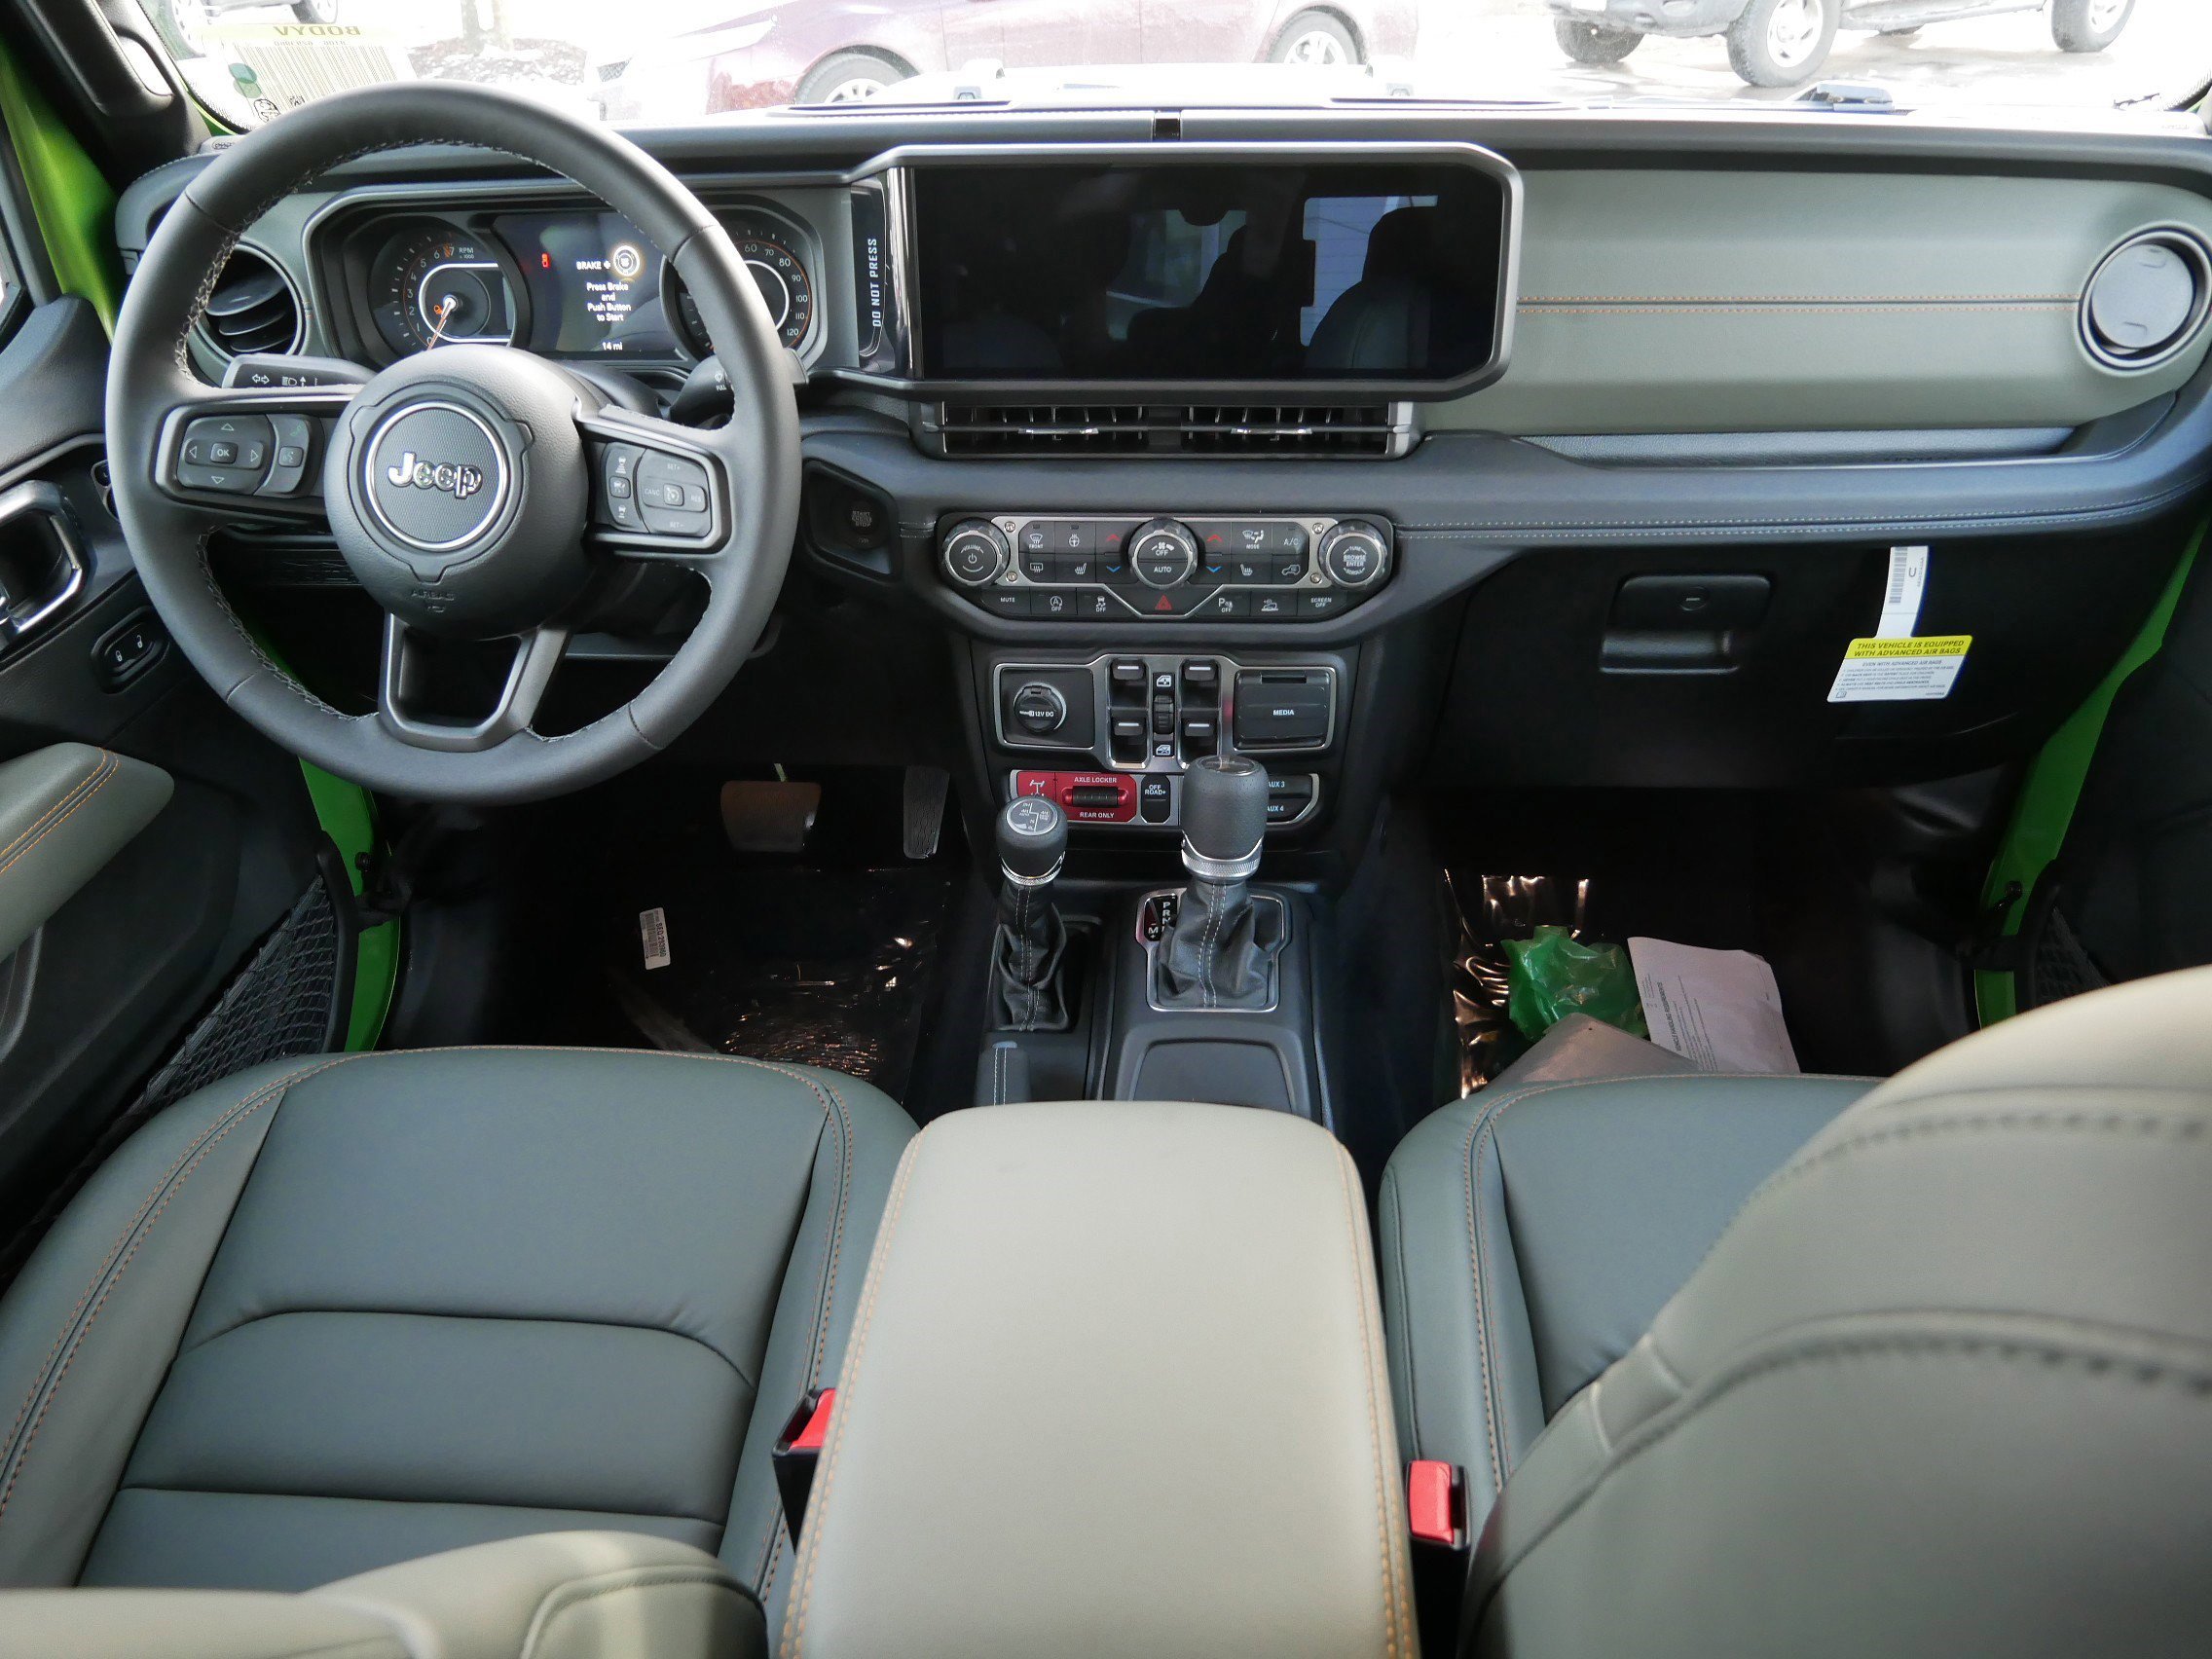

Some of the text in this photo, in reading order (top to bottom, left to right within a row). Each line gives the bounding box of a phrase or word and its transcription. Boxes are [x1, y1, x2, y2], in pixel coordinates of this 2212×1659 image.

[433, 249, 440, 259] 6
[449, 246, 456, 256] 7
[420, 258, 427, 268] 5
[576, 260, 603, 271] BRAKE
[779, 258, 792, 267] 80
[411, 273, 417, 281] 4
[792, 274, 802, 282] 90
[586, 281, 629, 291] Press Brake
[867, 239, 882, 327] DO NOT PRESS
[407, 288, 414, 299] 3
[601, 292, 616, 302] and
[409, 306, 415, 316] 2
[587, 302, 632, 312] Push Button
[596, 313, 624, 322] to Start
[787, 328, 799, 337] 120
[603, 342, 623, 350] 14 mi
[216, 448, 230, 457] OK
[387, 452, 484, 499] Jeep
[644, 488, 660, 497] CANC
